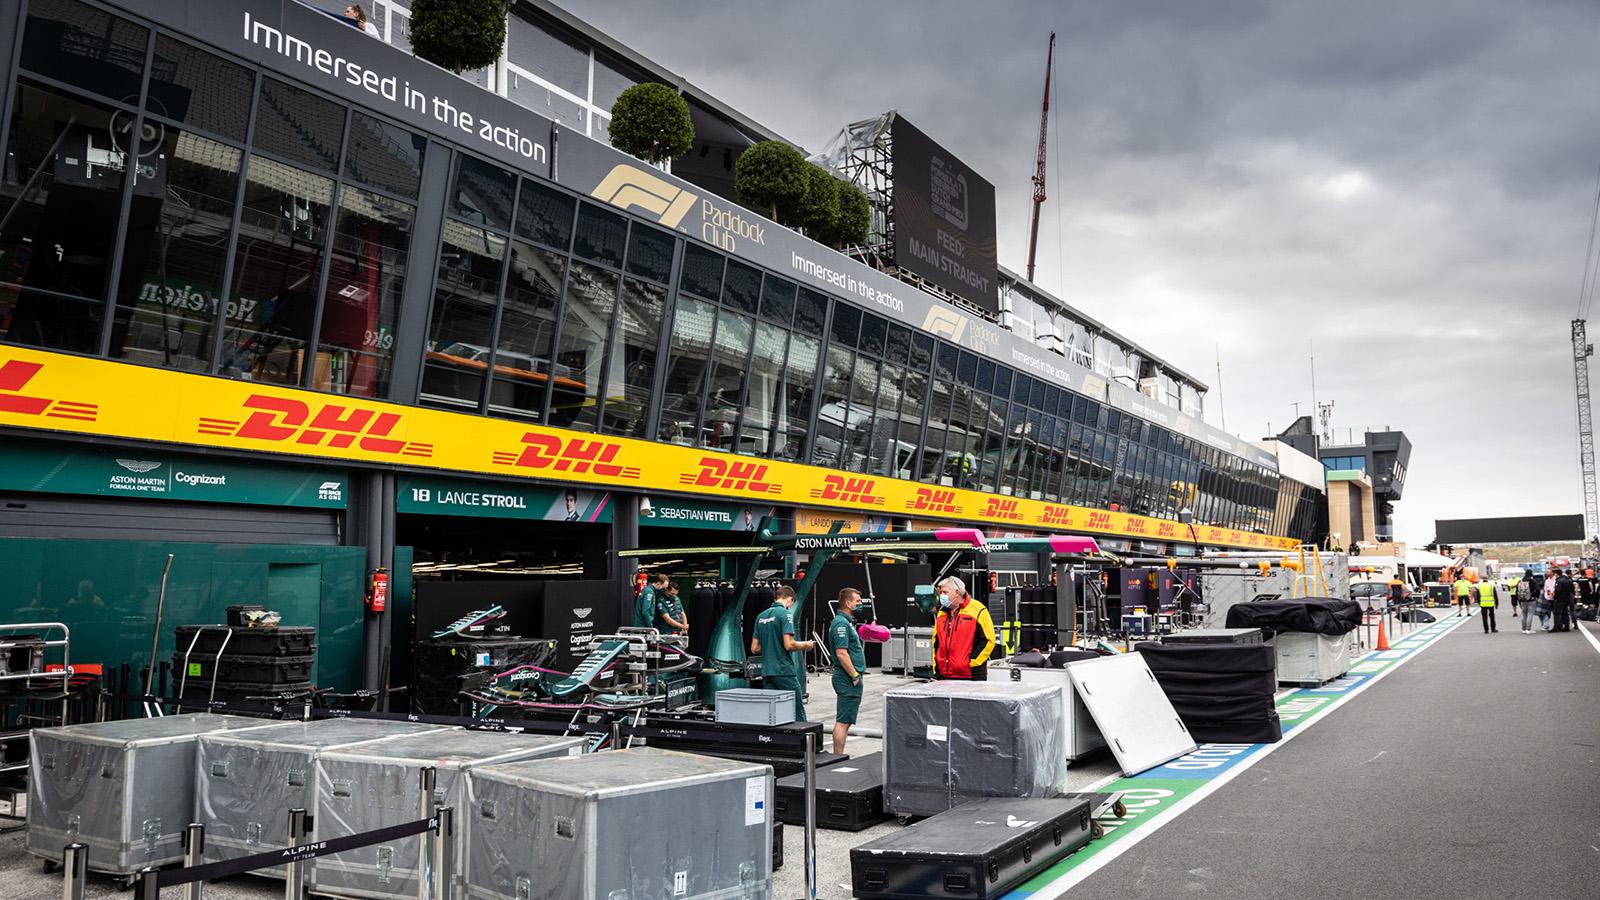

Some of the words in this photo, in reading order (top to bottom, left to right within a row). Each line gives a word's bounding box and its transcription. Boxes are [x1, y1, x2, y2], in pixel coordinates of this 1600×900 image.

[243, 12, 397, 101] Immersed
[404, 81, 426, 114] in
[433, 96, 473, 134] the
[479, 118, 546, 164] action
[702, 199, 765, 245] Paddock
[702, 222, 735, 252] Club
[937, 228, 964, 259] FEED:
[909, 237, 939, 268] MAIN
[941, 257, 989, 293] STRAIGHT
[792, 251, 847, 287] Immersed
[847, 275, 857, 291] in
[858, 281, 875, 301] the
[876, 290, 904, 313] action
[1012, 347, 1041, 370] Immersed
[235, 394, 407, 454] DHL
[515, 432, 621, 476] DHL
[110, 476, 135, 485] ASTON
[137, 477, 165, 486] MARTIN
[110, 483, 136, 491] FORMULA
[175, 472, 226, 486] Cognizant
[695, 457, 770, 493] DHL
[412, 488, 430, 502] 18
[437, 490, 480, 506] LANCE
[482, 494, 526, 509] STROLL
[821, 474, 875, 504] DHL
[914, 487, 955, 513] DHL
[660, 507, 704, 520] SEBASTIAN
[704, 510, 732, 523] VETTEL
[985, 498, 1018, 519] DHL
[1043, 506, 1069, 524] DHL
[795, 539, 822, 548] ASTON
[282, 842, 327, 857] ALPINE
